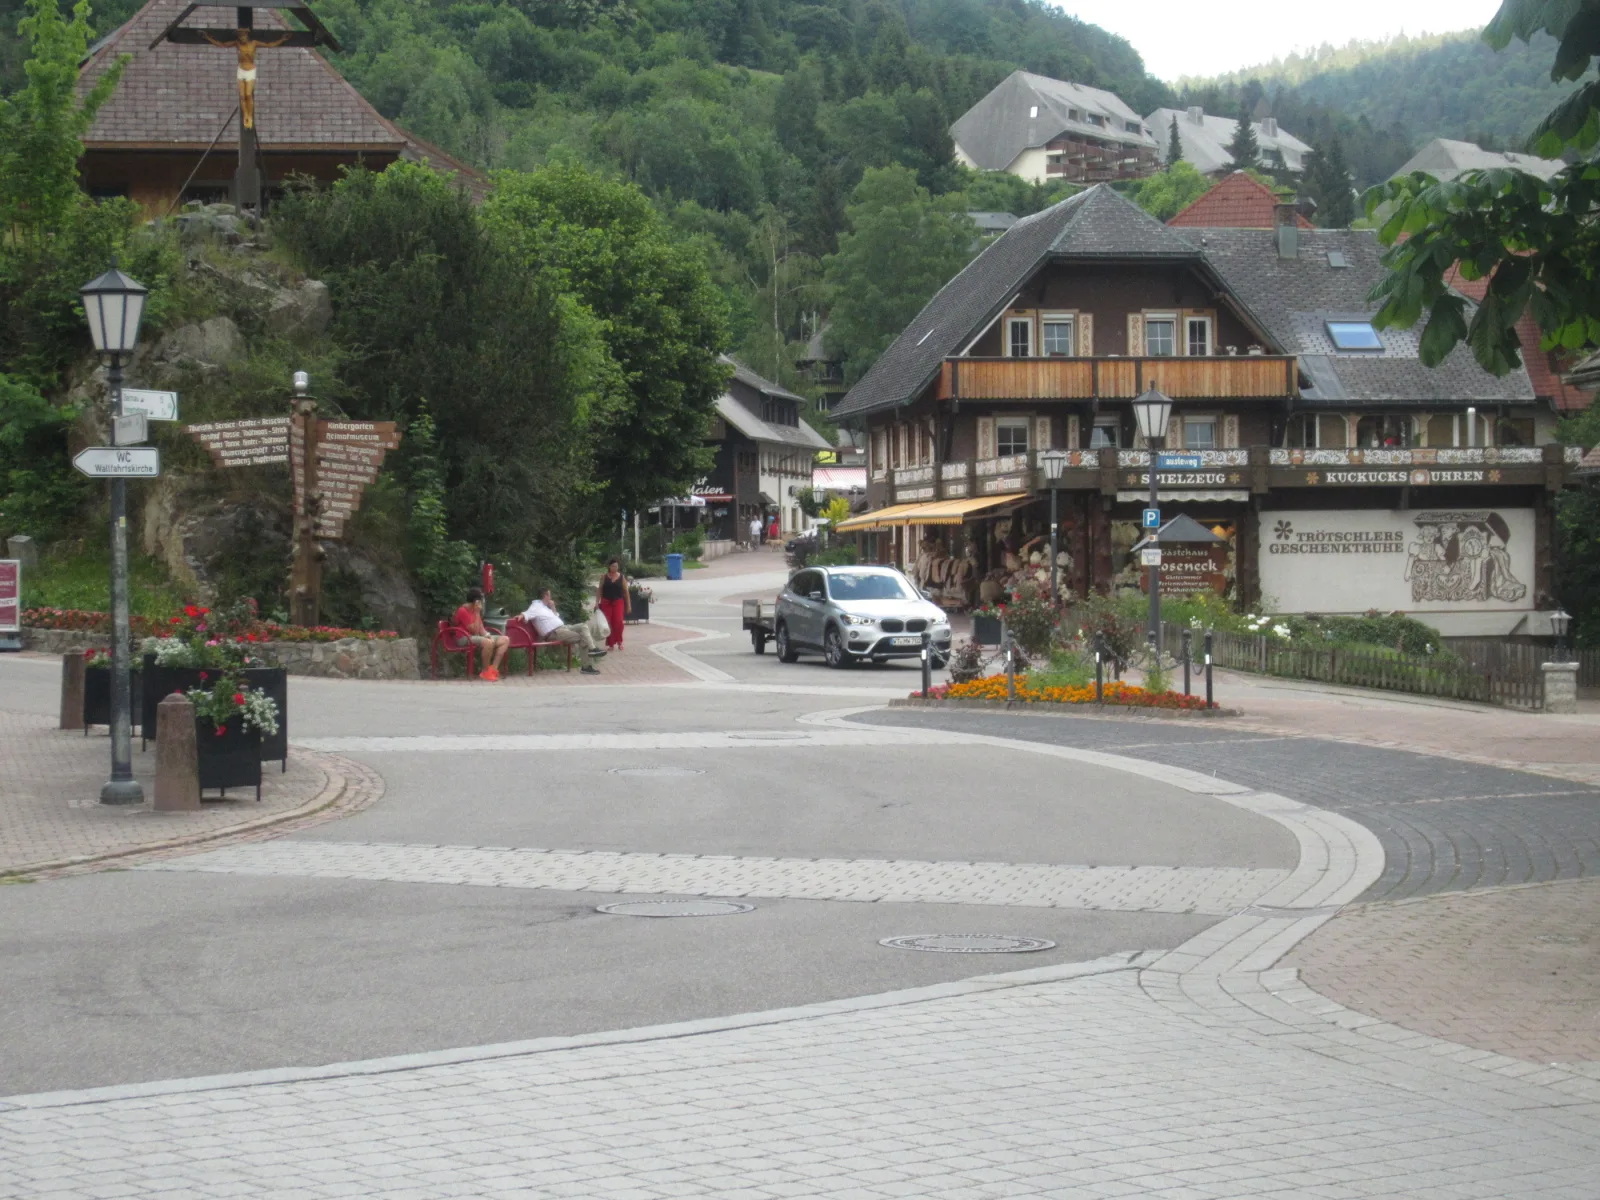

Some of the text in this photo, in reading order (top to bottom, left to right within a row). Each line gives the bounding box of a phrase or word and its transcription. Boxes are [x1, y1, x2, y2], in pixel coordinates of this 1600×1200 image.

[327, 422, 374, 431] Kindergarten
[326, 432, 379, 440] Heimatmuseum
[116, 452, 131, 462] WC
[94, 464, 153, 473] Wallfahrtskirche
[1326, 470, 1484, 483] KUCKUCKS UHREN
[1147, 512, 1156, 525] P
[1296, 530, 1404, 542] TRÖTSCHLERS
[1269, 543, 1404, 555] GESCHENKTRUHE
[1158, 558, 1218, 571] oseneck
